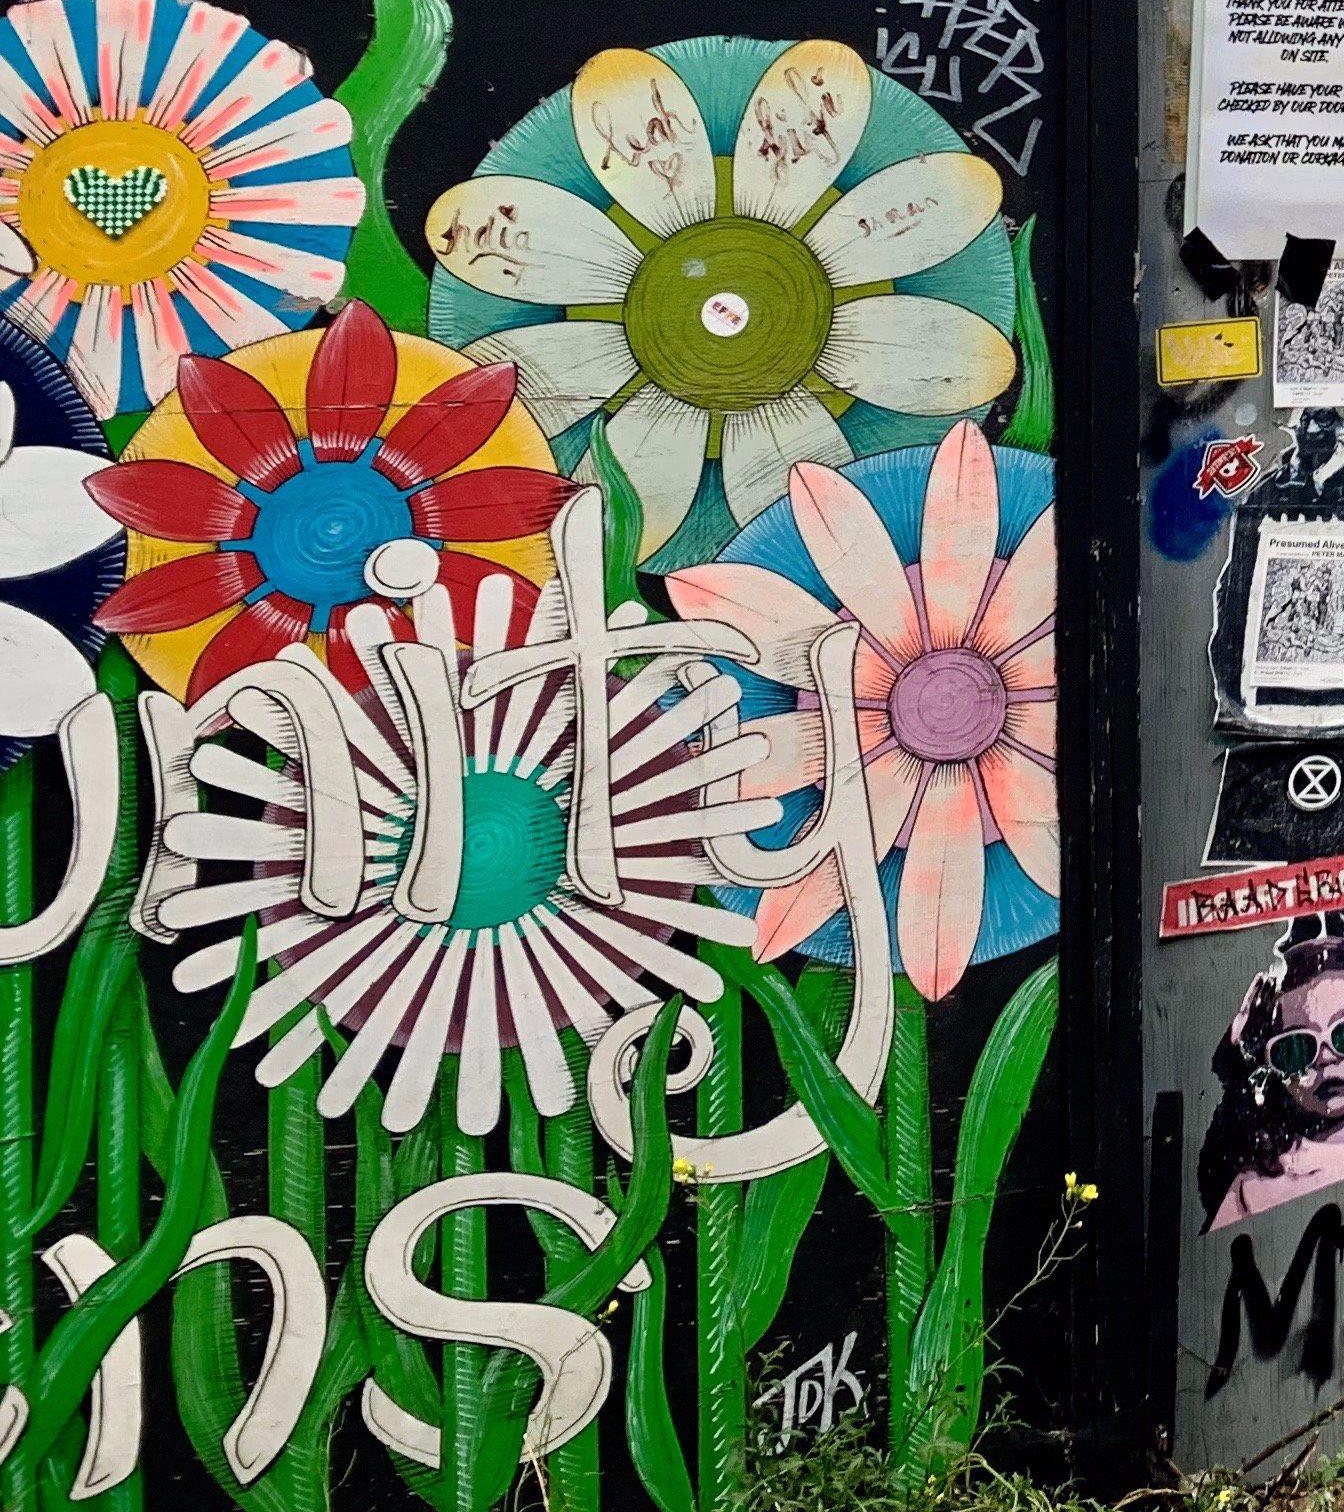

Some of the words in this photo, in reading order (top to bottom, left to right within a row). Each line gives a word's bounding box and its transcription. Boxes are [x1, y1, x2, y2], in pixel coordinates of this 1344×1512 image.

[1229, 12, 1274, 26] PLEASE
[1275, 14, 1292, 26] BE
[1292, 15, 1337, 28] AWARE
[1228, 30, 1256, 43] NOT
[1253, 31, 1317, 45] ALLOWING
[1318, 33, 1344, 48] ANY
[1281, 49, 1299, 62] ON
[1230, 81, 1275, 96] PLEASE
[1276, 83, 1311, 96] HAVE
[1310, 84, 1342, 98] YOUR
[1217, 98, 1271, 114] CHECKED
[1272, 100, 1292, 115] BY
[1290, 100, 1318, 114] OUR
[1227, 134, 1249, 146] WE
[1249, 134, 1275, 148] ASK
[1275, 134, 1307, 148] THAT
[1306, 135, 1330, 150] YOU
[1220, 150, 1280, 165] DONATION
[1282, 151, 1300, 164] OR
[1270, 538, 1320, 548] Presumed
